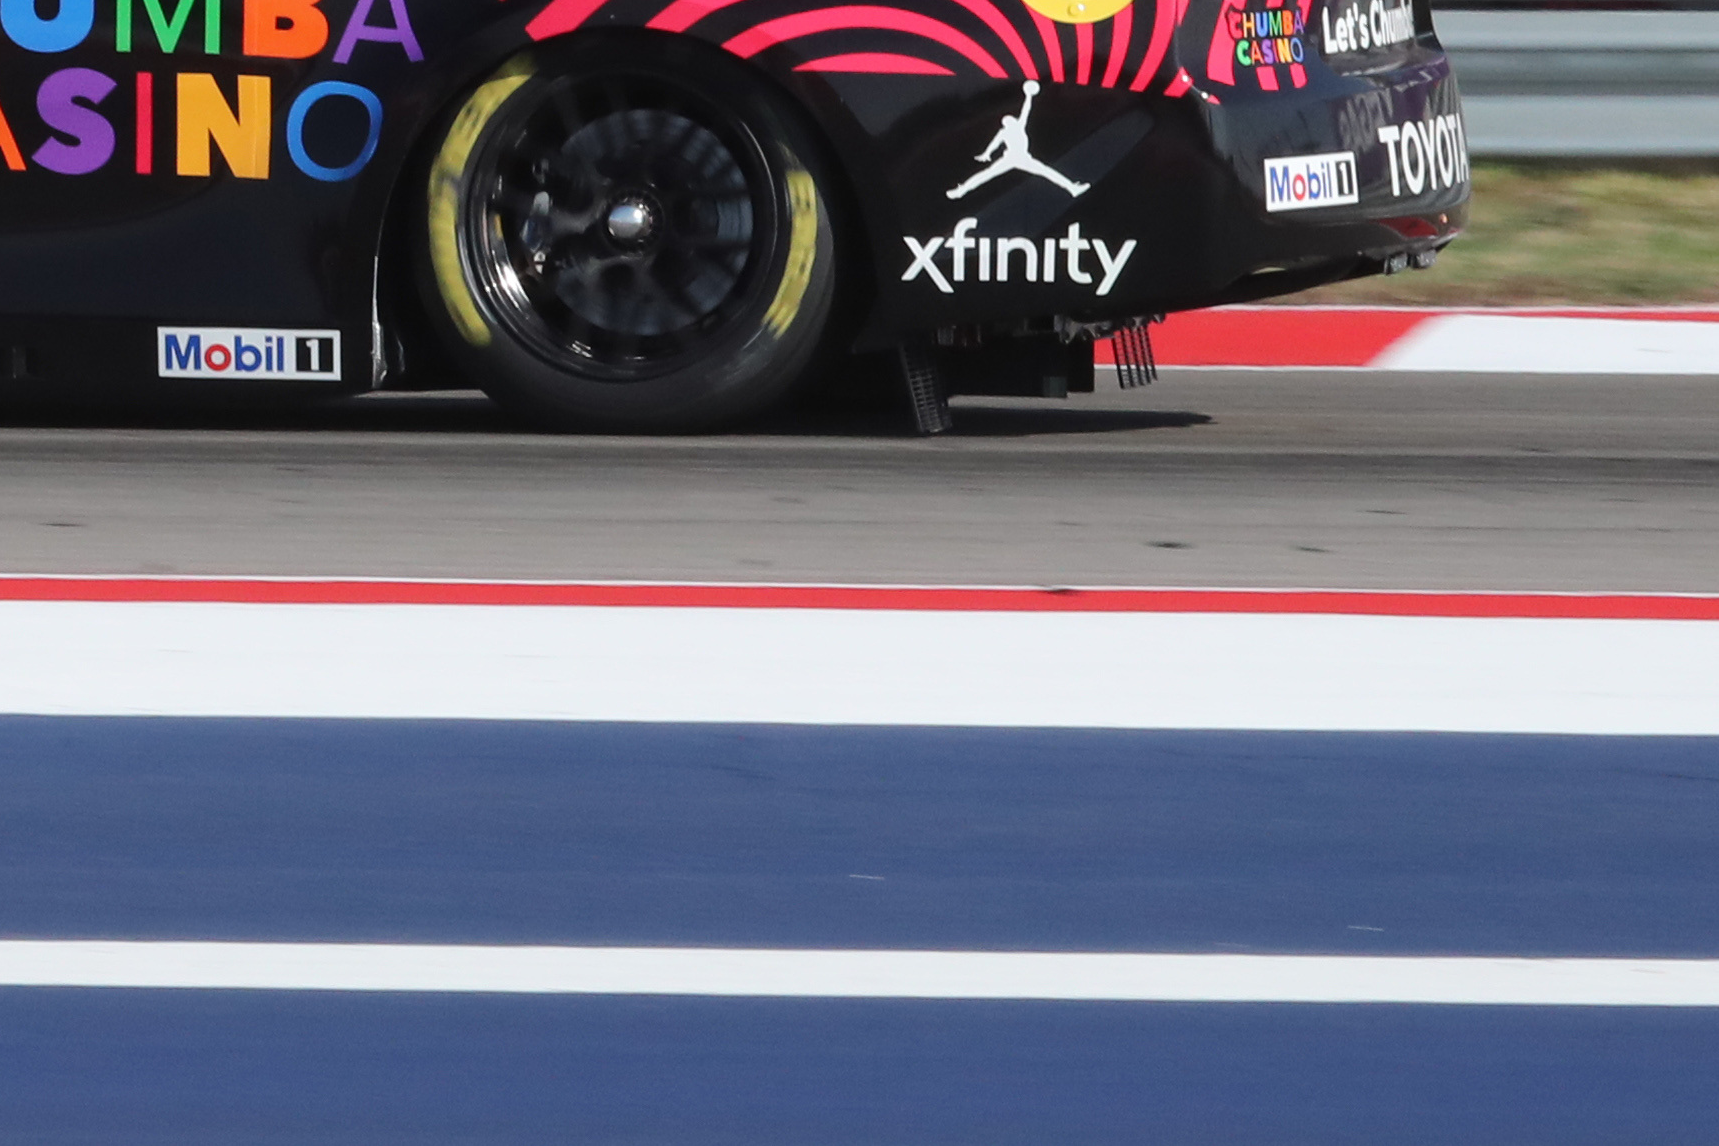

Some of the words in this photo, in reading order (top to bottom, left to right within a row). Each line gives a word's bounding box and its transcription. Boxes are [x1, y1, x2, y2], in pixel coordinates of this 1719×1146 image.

[1225, 7, 1305, 40] CHUMBA
[1321, 1, 1371, 55] Let's
[1236, 37, 1305, 66] CASINO
[1377, 112, 1470, 197] TOYOTA
[1269, 161, 1333, 204] Mobil
[1336, 161, 1353, 197] 1
[900, 216, 1138, 296] xfinity
[164, 333, 285, 372] Mobil
